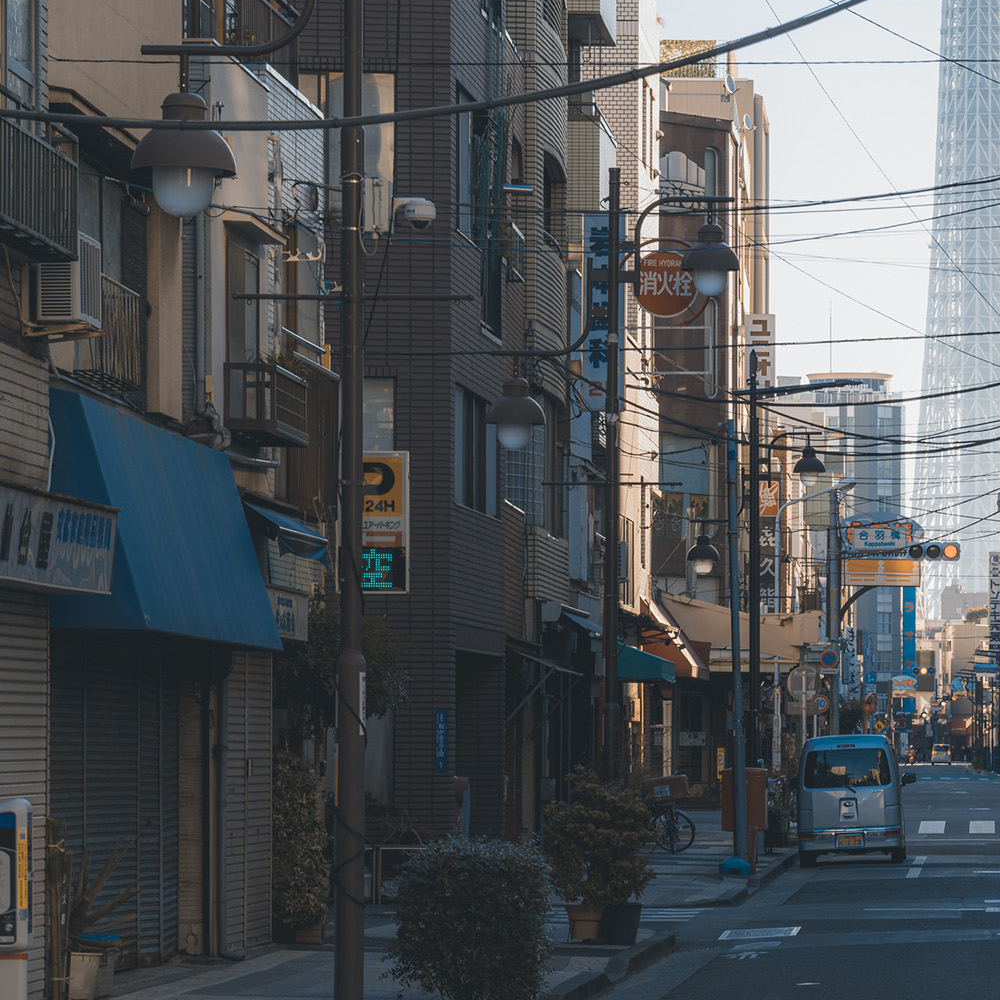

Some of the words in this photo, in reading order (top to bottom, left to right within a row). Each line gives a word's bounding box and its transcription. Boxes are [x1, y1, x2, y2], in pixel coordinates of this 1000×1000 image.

[643, 259, 657, 267] FIRE
[659, 259, 682, 267] HYDRAN
[640, 271, 693, 296] 消火栓
[750, 319, 771, 389] ユニオ
[365, 500, 395, 512] 24H
